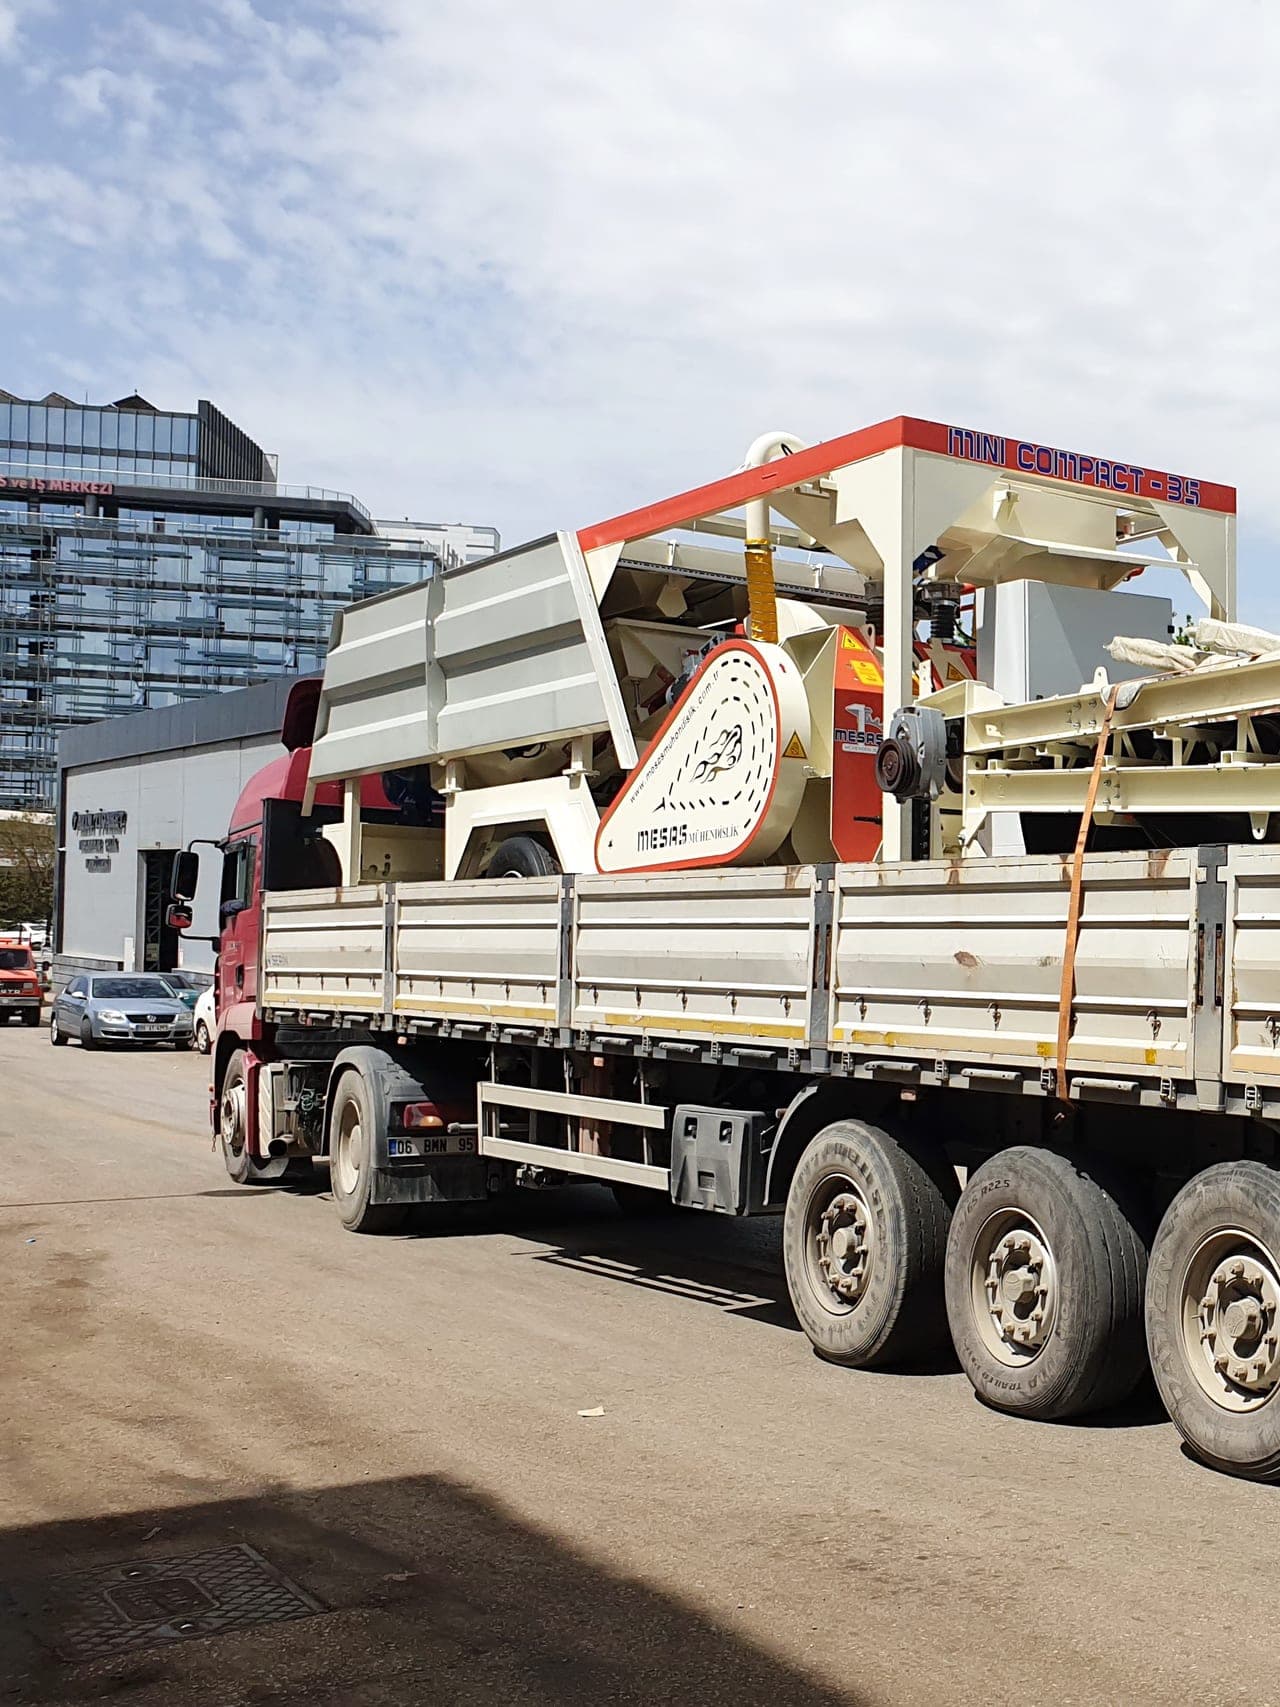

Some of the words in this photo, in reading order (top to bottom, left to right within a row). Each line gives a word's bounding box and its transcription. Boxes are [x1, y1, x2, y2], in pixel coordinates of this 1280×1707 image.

[947, 427, 1006, 466] MINI
[11, 479, 27, 489] ve
[834, 727, 884, 746] MESAS
[637, 823, 688, 852] MESAS
[688, 823, 739, 844] MÜHENDİSLİK
[397, 1140, 413, 1154] 06
